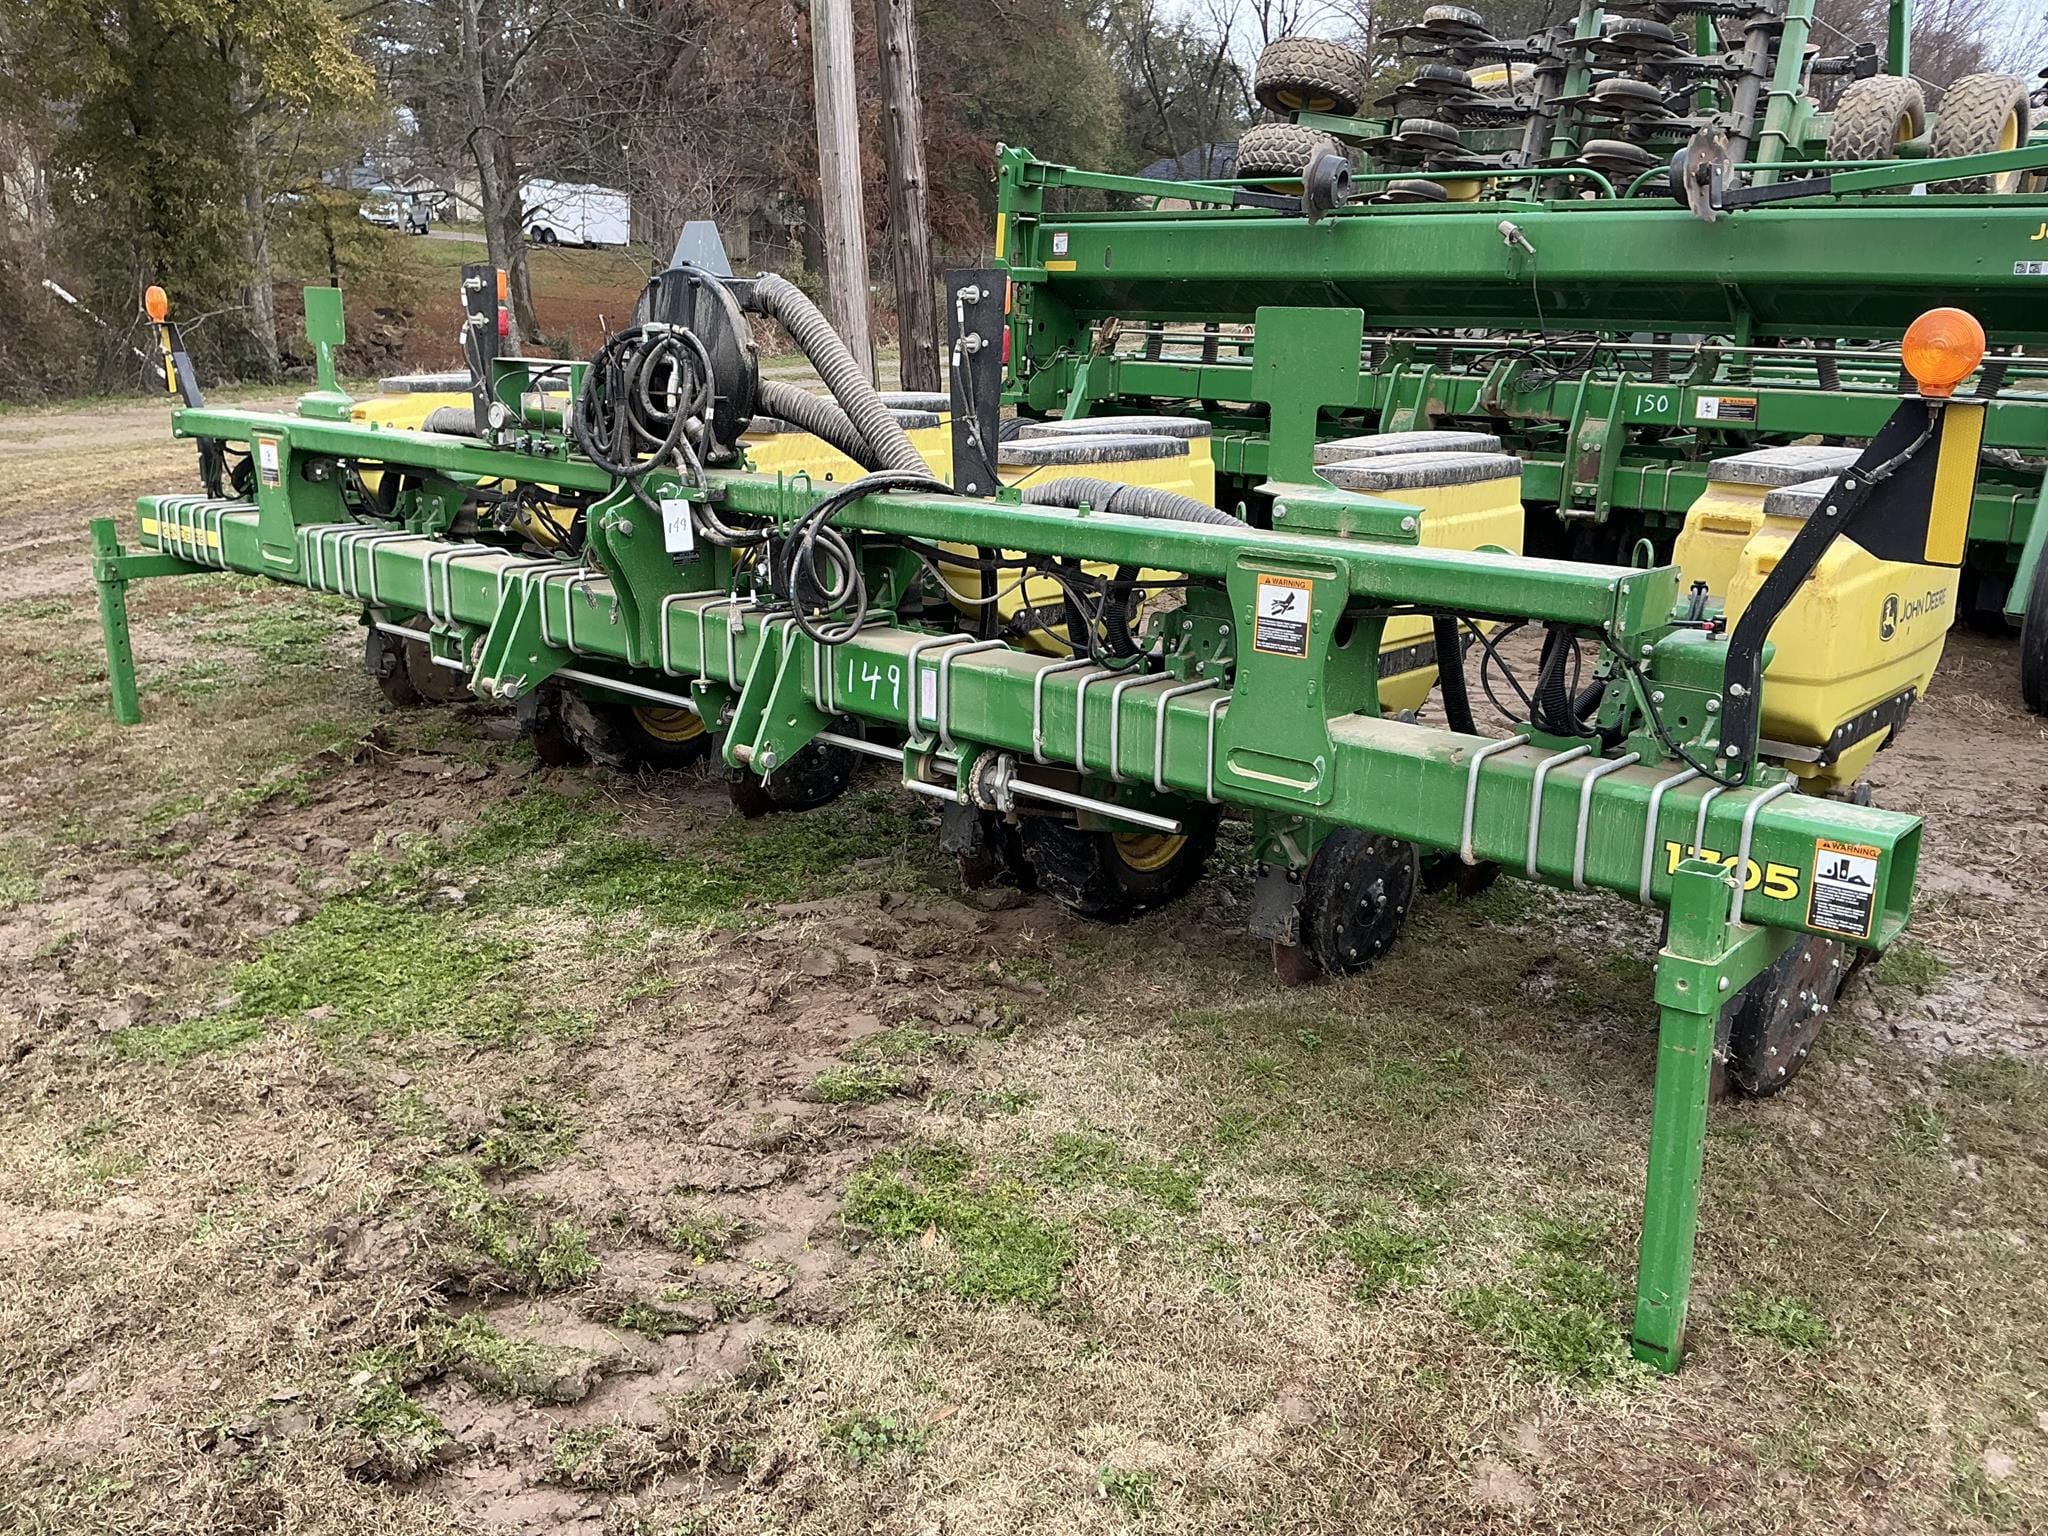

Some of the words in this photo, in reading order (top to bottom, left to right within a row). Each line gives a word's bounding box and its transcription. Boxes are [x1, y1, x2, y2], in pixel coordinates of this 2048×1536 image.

[2030, 222, 2048, 241] J
[1635, 394, 1669, 416] 150
[668, 516, 687, 534] 149
[1271, 577, 1306, 589] WARNING
[1899, 597, 1925, 623] JOHN
[1924, 587, 1947, 614] DEERE
[848, 658, 900, 711] 149
[1831, 842, 1878, 857] WARNING
